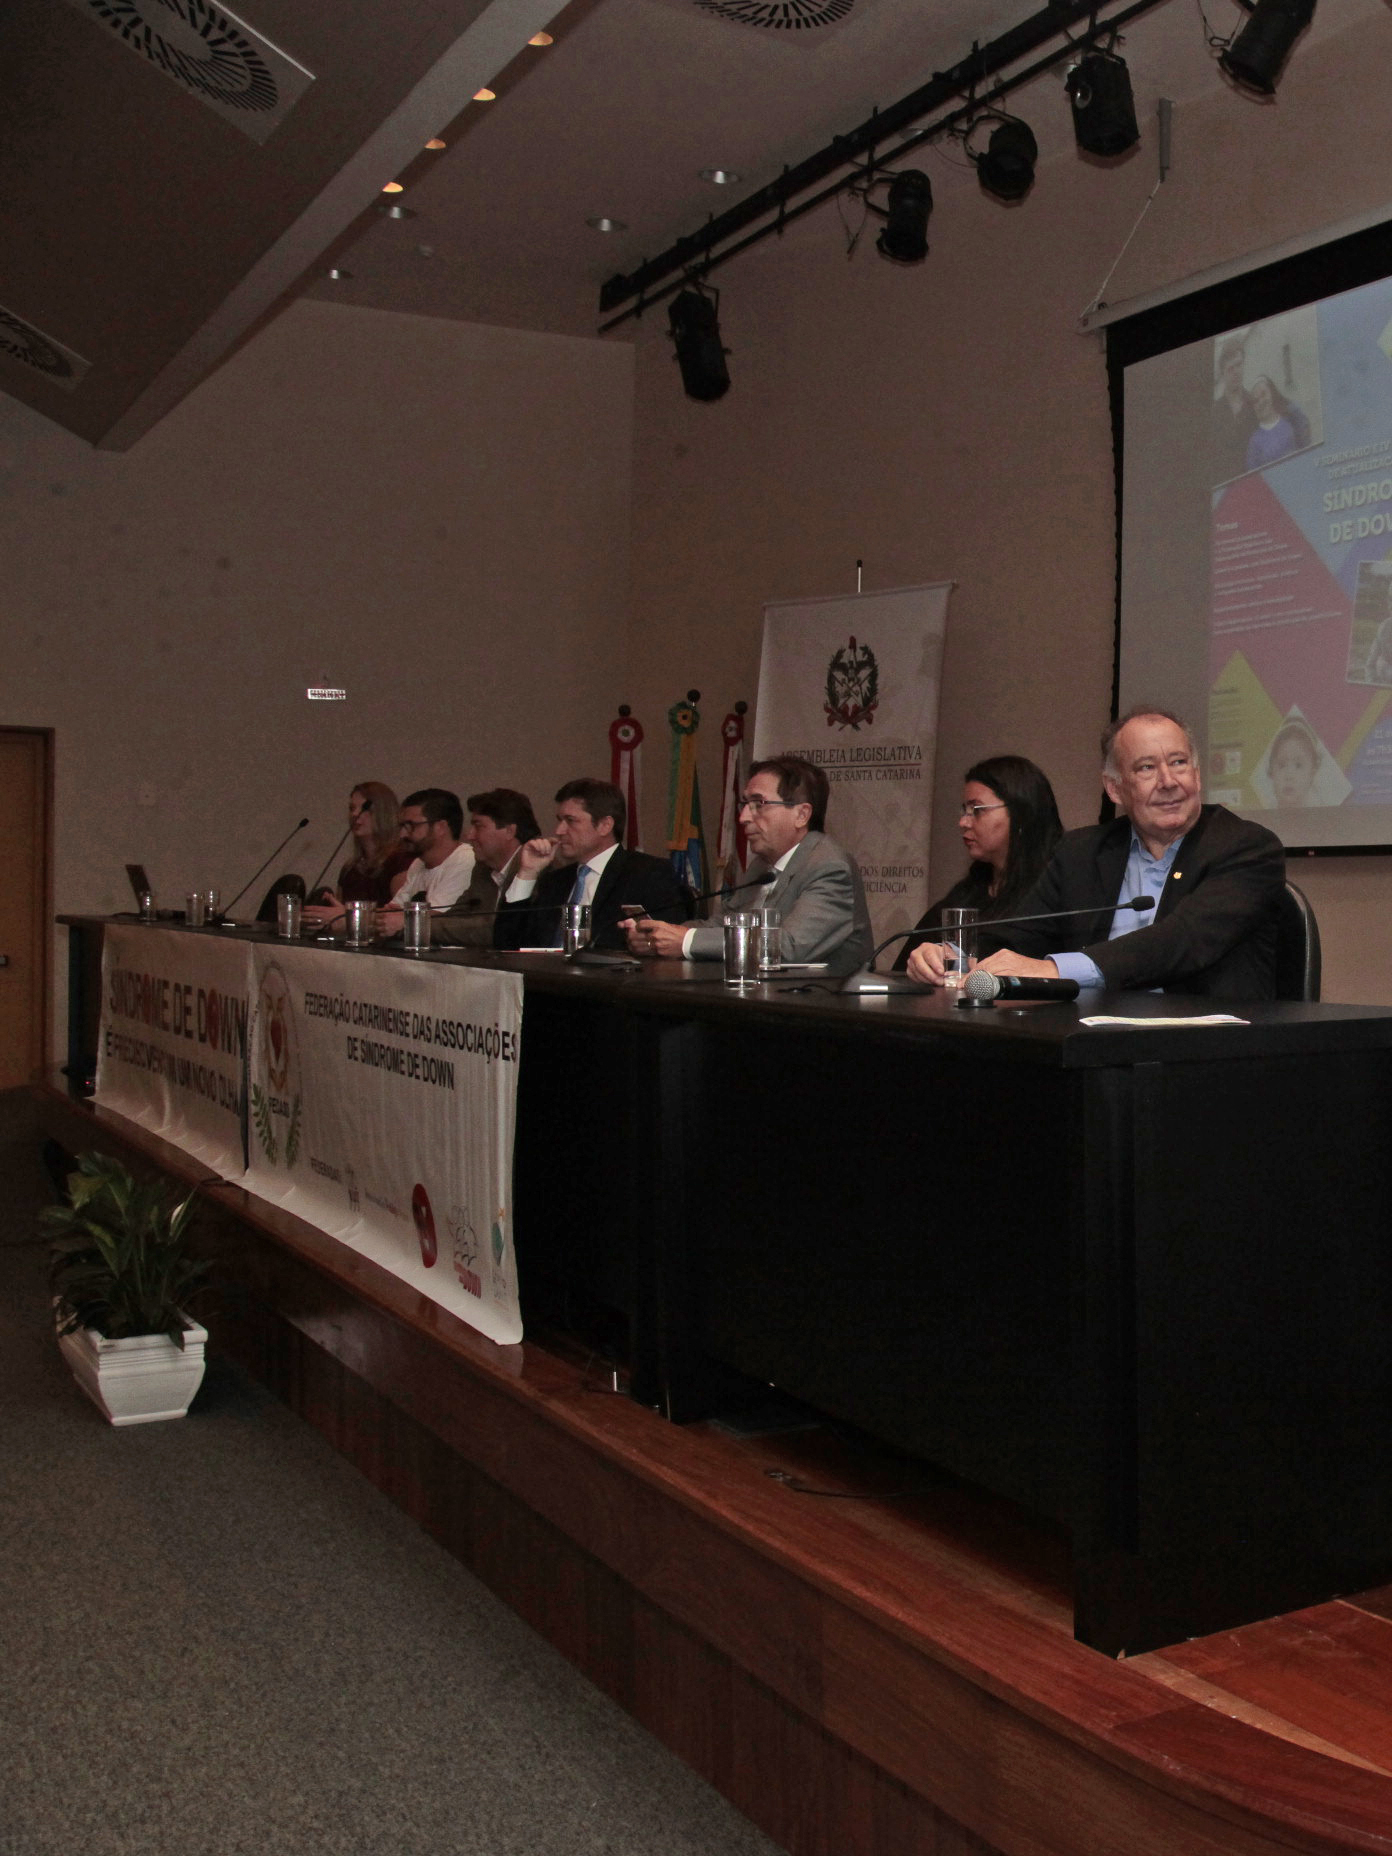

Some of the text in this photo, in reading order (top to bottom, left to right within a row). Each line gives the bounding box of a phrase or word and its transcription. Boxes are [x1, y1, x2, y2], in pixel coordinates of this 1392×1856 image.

[1329, 520, 1353, 544] DE
[850, 745, 922, 763] LEGISLATIVA
[829, 768, 921, 782] DE SANTA CATARINA
[881, 866, 925, 879] DIREITOS
[173, 982, 194, 1039] DE
[304, 992, 517, 1064] FEDERAÇÃO CATARINENSE DAS ASSOCIAÇÕES
[347, 1033, 455, 1090] DE SÍNDROME DE DOWN
